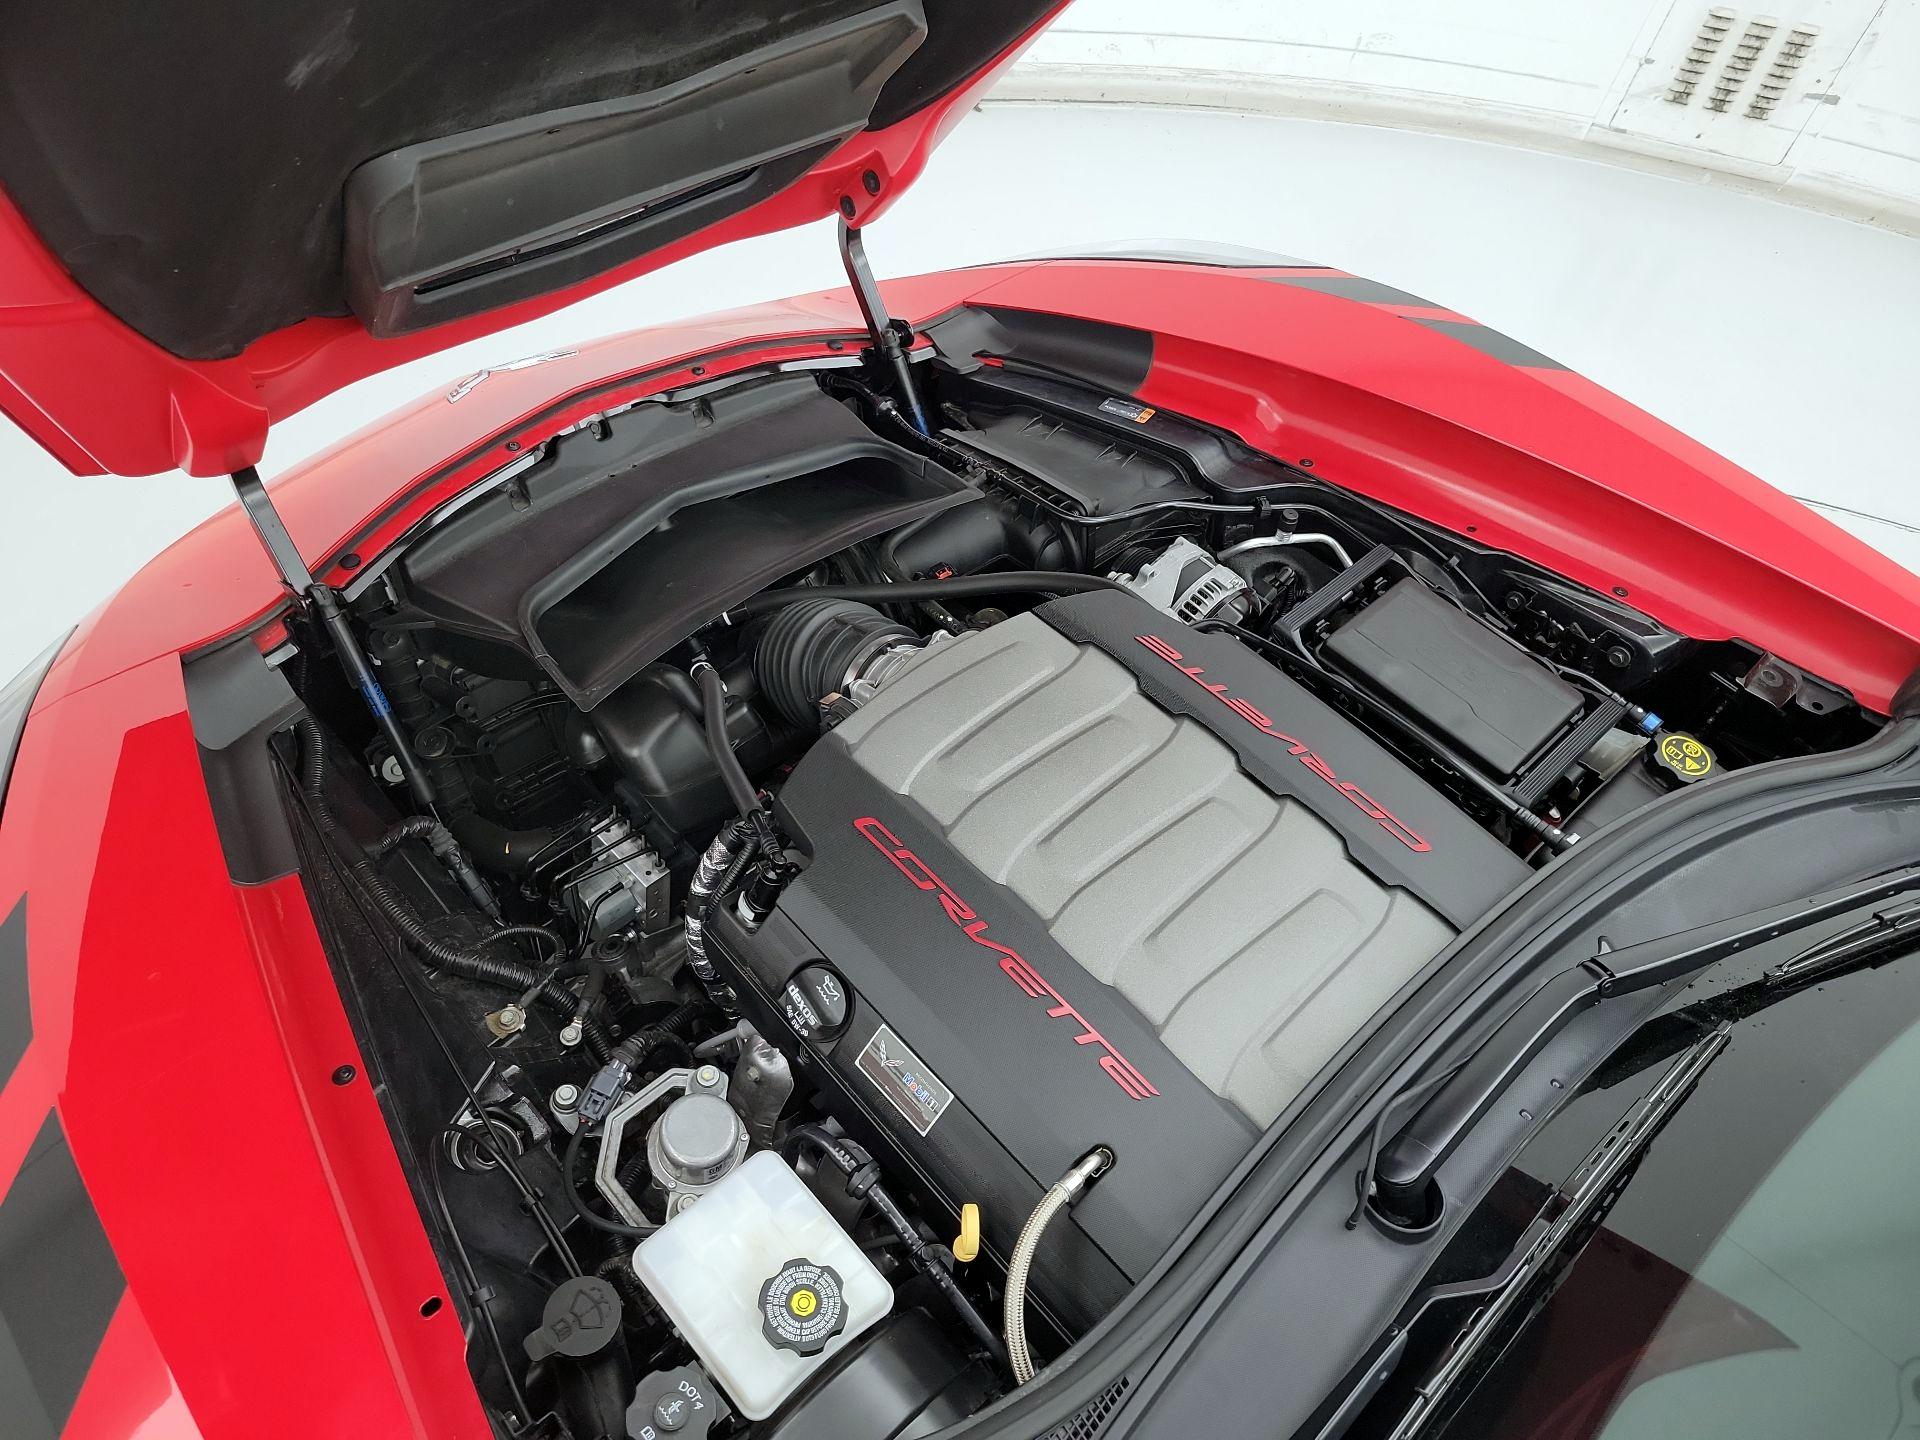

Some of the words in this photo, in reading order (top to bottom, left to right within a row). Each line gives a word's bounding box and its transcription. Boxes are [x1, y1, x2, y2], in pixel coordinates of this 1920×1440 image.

[1134, 635, 1432, 852] CORVETTE
[854, 817, 1160, 1100] CORVETTE
[786, 1004, 794, 1019] SAE
[788, 984, 818, 1026] dexos
[902, 1072, 928, 1104] Mobil
[678, 1380, 702, 1402] DOT
[693, 1401, 704, 1411] 4
